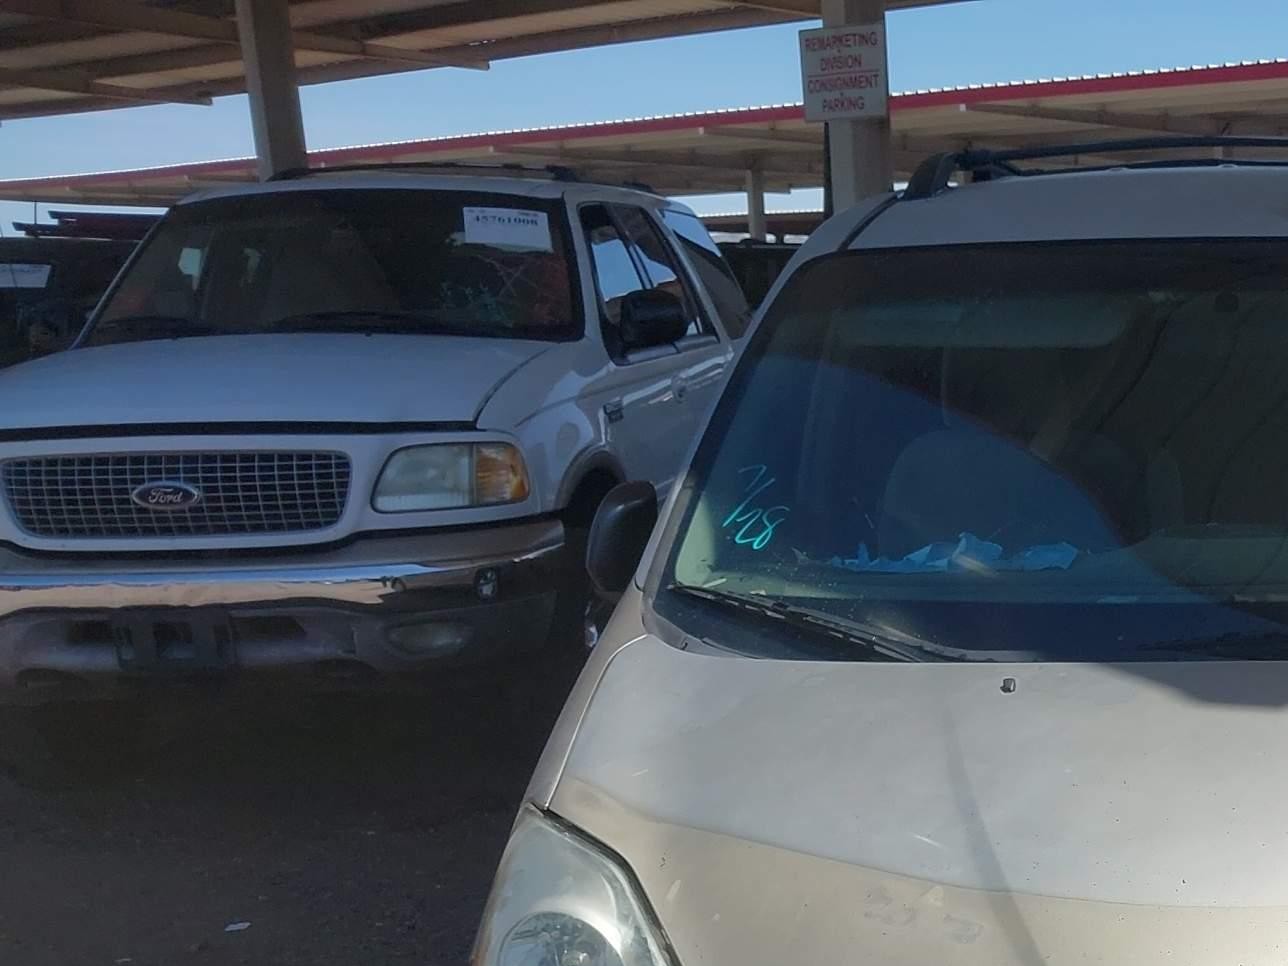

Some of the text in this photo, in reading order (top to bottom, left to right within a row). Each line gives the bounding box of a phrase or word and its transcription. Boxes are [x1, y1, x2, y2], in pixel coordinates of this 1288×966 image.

[804, 31, 878, 50] REMARKETING
[820, 55, 863, 71] DIVISION
[807, 74, 879, 93] CONSIGNMENT
[823, 96, 865, 112] PARKING
[148, 487, 184, 504] Ford
[722, 464, 791, 550] 7/28
